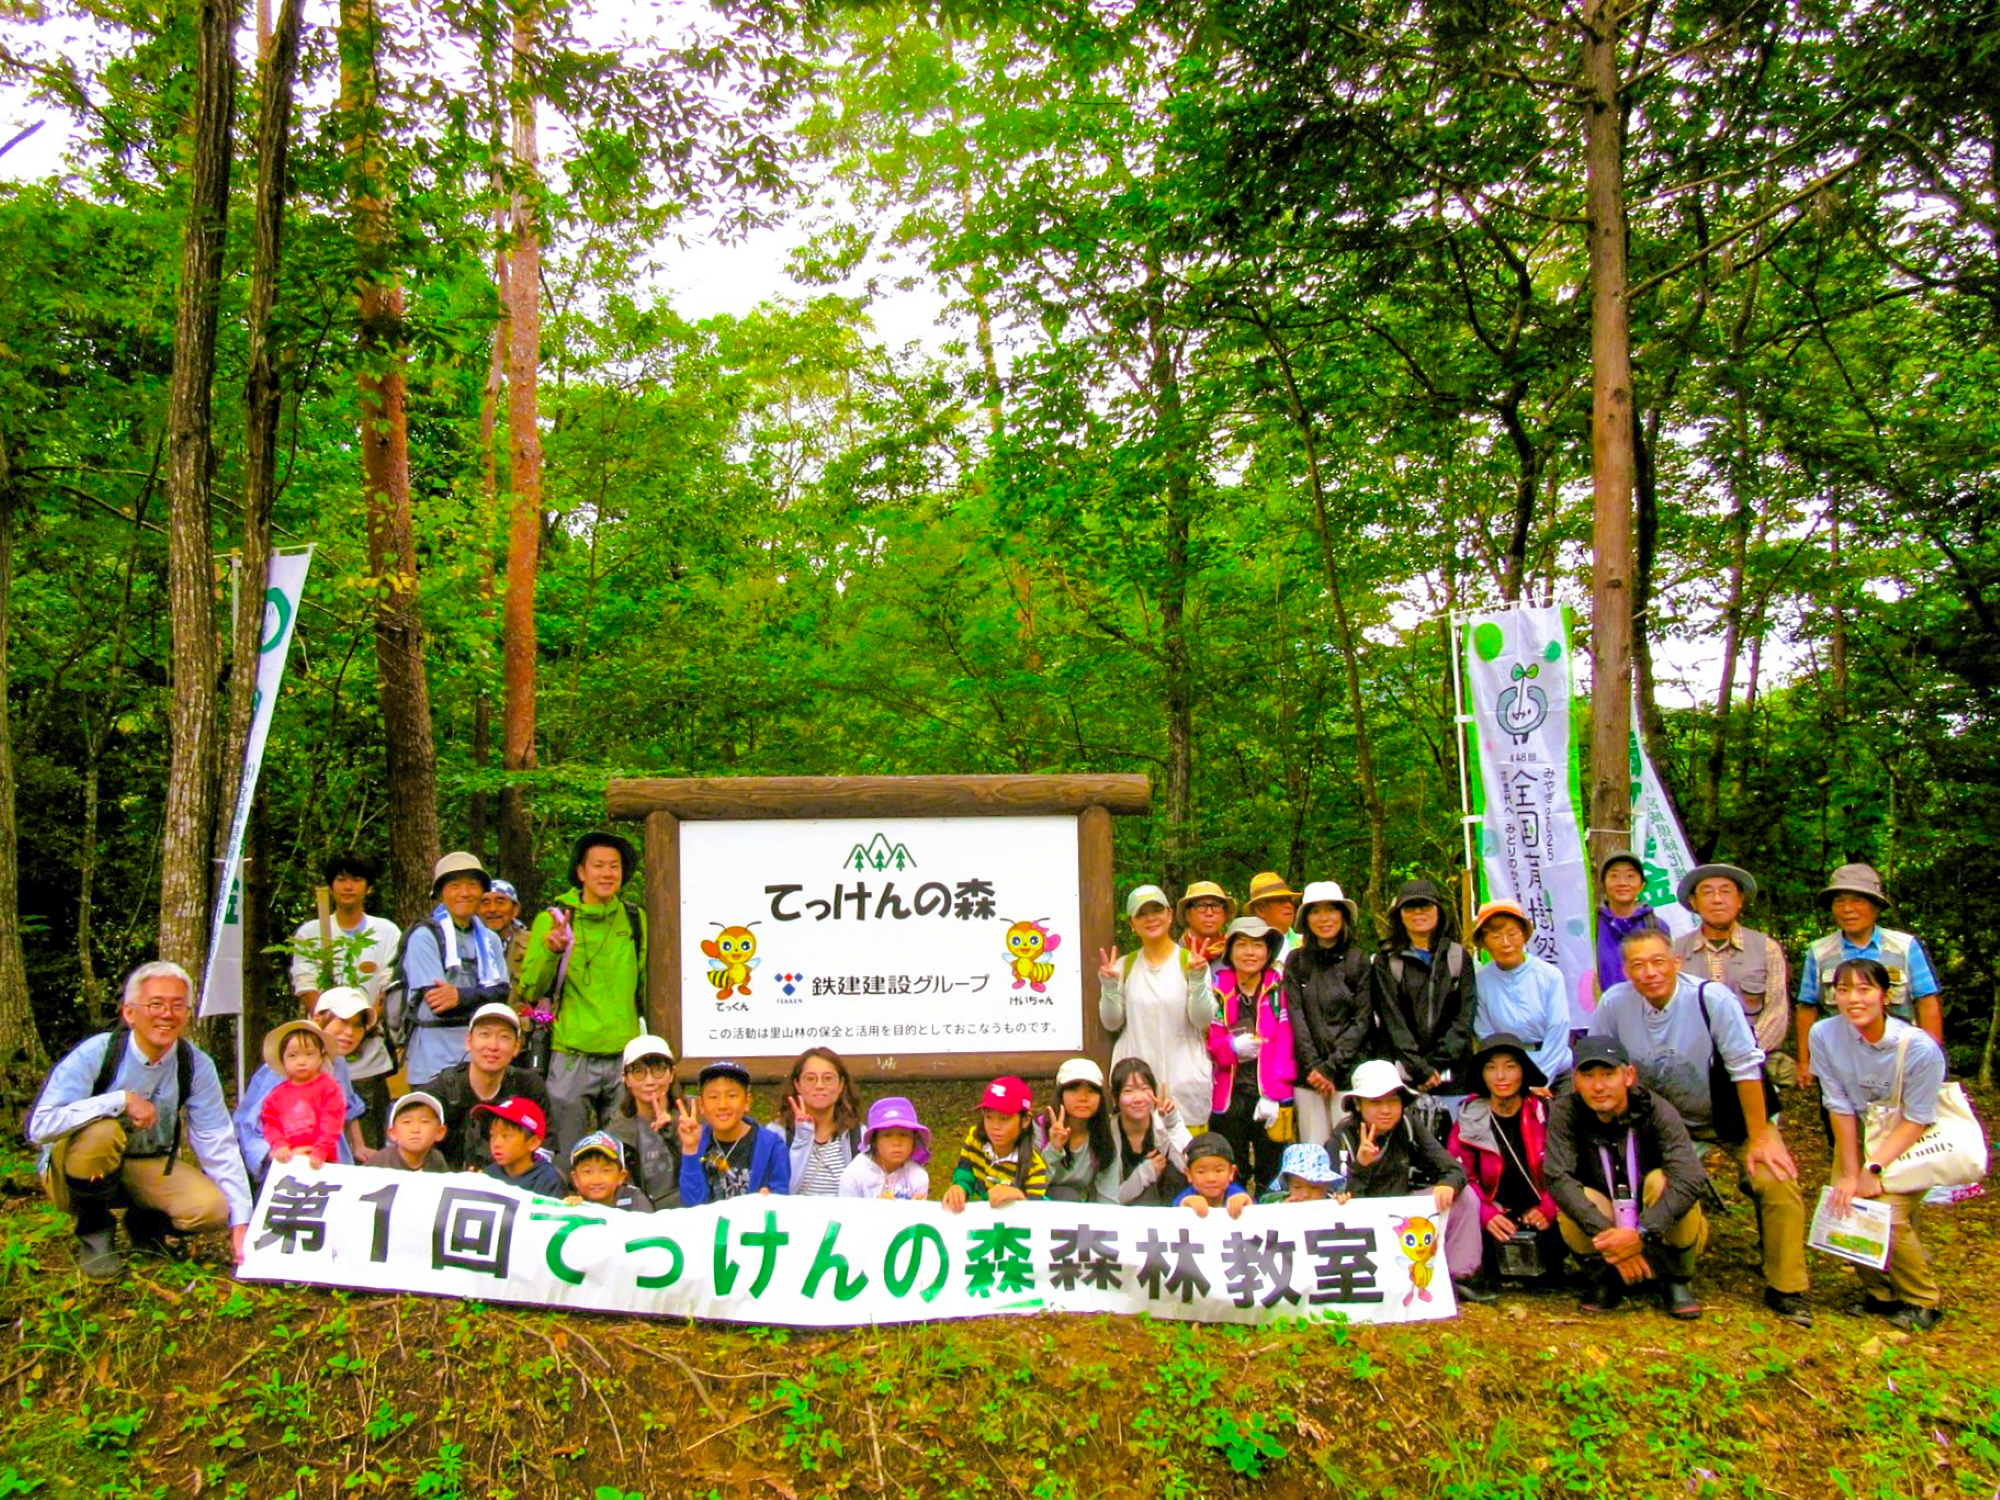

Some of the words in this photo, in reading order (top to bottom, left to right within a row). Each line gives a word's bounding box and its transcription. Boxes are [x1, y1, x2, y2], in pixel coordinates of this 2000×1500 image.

[765, 878, 996, 921] てっけんの森
[812, 973, 990, 996] 鉄建建設グループ
[716, 1002, 749, 1012] てっくん
[1009, 996, 1054, 1006] けいちゃん
[708, 1021, 1057, 1040] この活動は里山林の保全と活用を目的としておこなうものです。
